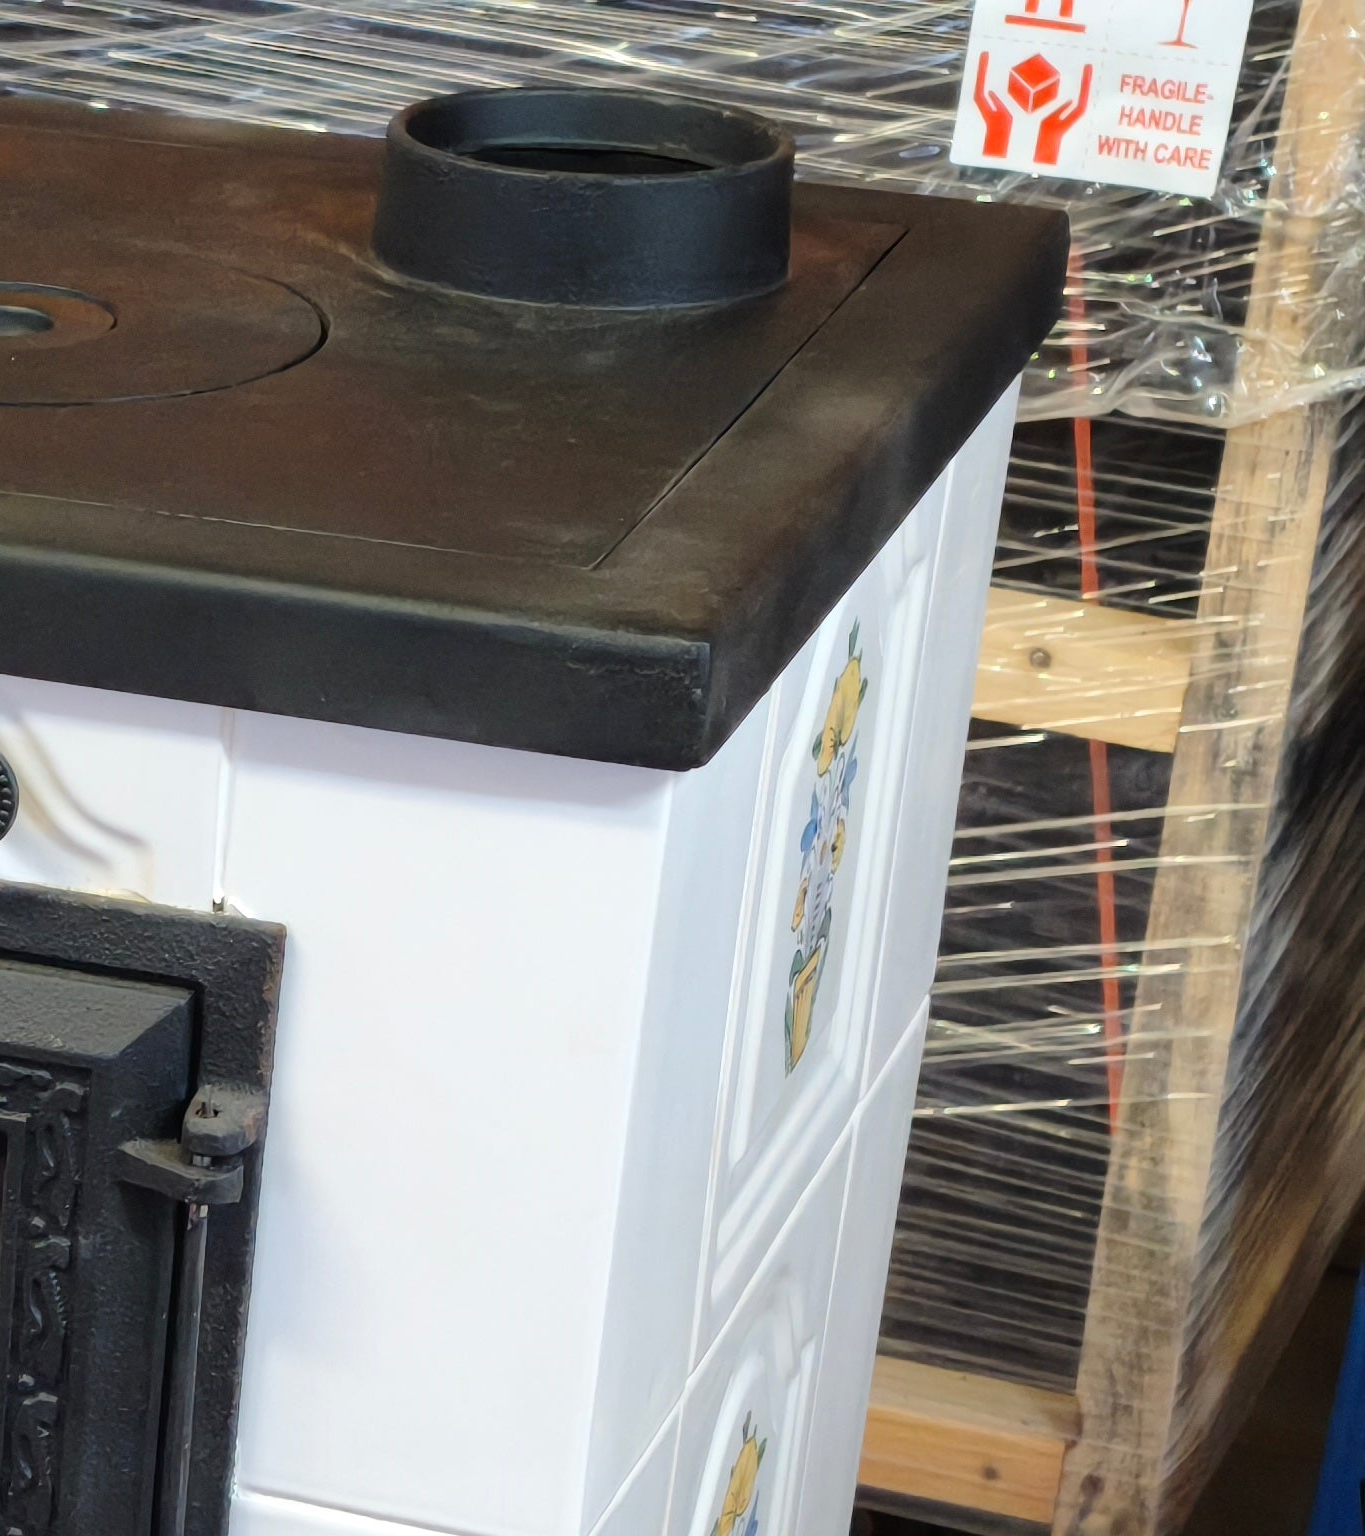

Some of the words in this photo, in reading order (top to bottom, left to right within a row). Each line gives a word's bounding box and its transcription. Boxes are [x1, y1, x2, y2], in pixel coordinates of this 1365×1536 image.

[1118, 105, 1204, 136] HANDLE
[1097, 134, 1149, 162] WITH
[1153, 143, 1213, 170] CARE
